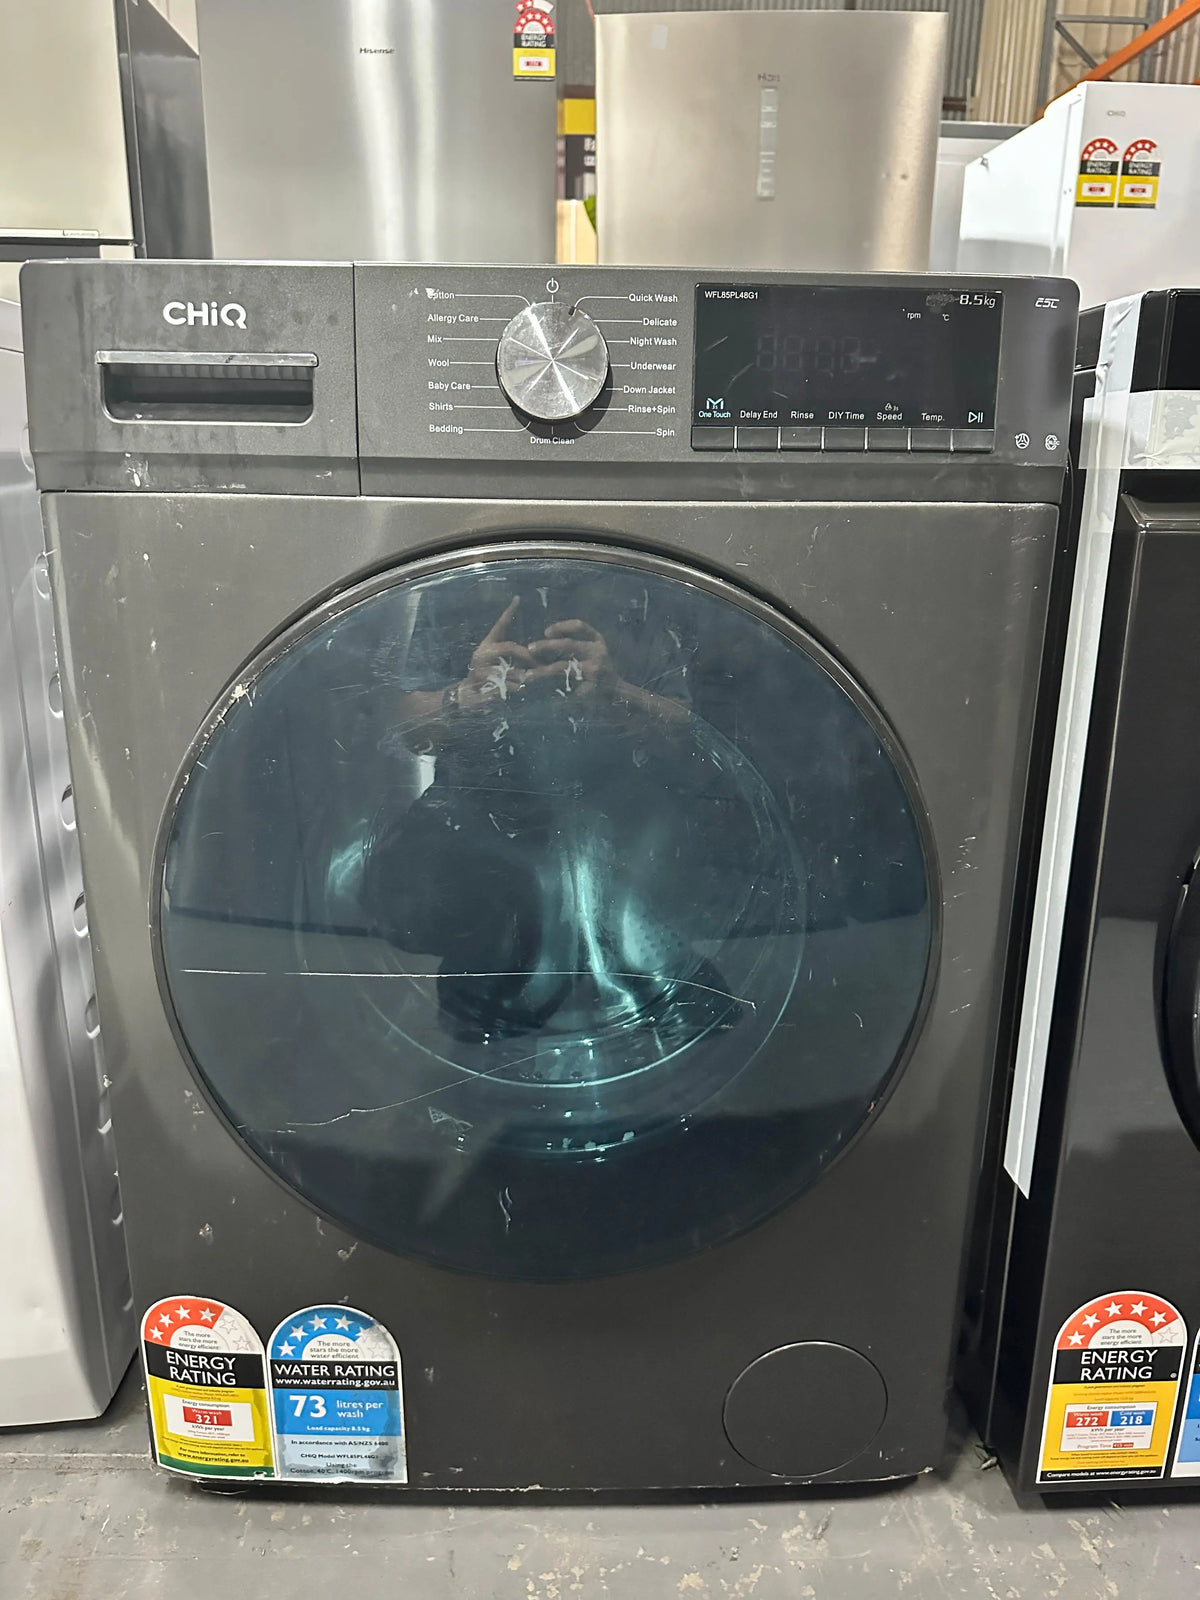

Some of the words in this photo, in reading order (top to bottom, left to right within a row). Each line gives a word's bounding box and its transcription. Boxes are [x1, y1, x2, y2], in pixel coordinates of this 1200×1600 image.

[628, 293, 653, 303] Quick
[654, 294, 678, 303] Wash
[704, 290, 759, 300] WFL85PL48G1
[959, 294, 996, 309] 8.5kg
[427, 313, 457, 324] Allergy
[458, 314, 479, 323] Care
[907, 312, 922, 320] rpm
[642, 317, 678, 327] Delicate
[427, 334, 442, 343] Mix
[629, 336, 653, 347] Night
[653, 337, 678, 346] Wash
[428, 358, 450, 367] Wool
[630, 361, 677, 371] Underwear
[428, 381, 450, 392] Baby
[450, 382, 471, 391] Care
[623, 385, 647, 394] Down
[648, 386, 676, 395] Jacket
[428, 402, 454, 411] Shirts
[627, 404, 676, 416] Rinse+Spin
[698, 410, 713, 418] One
[739, 410, 762, 420] Delay
[763, 411, 778, 419] End
[790, 411, 815, 420] Rinse
[828, 411, 844, 420] DIY
[844, 412, 865, 420] Time
[876, 412, 903, 421] Speed
[921, 412, 945, 422] Temp.
[429, 424, 464, 435] Bedding
[656, 428, 675, 438] Spin
[530, 436, 551, 445] Drum
[552, 437, 575, 446] Clean
[166, 1350, 236, 1371] ENERGY
[1081, 1349, 1159, 1365] ENERGY
[274, 1363, 331, 1376] WATER
[334, 1364, 395, 1377] RATING
[1080, 1366, 1153, 1381] RATING
[169, 1366, 237, 1386] RATING
[275, 1377, 396, 1388] www.waterrating.gov.au
[182, 1399, 199, 1407] Energy
[289, 1395, 328, 1418] 73
[336, 1399, 363, 1409] litres
[365, 1401, 384, 1412] per
[336, 1409, 364, 1418] wash
[195, 1414, 218, 1425] 321
[1075, 1416, 1099, 1427] 272
[1120, 1415, 1144, 1425] 218
